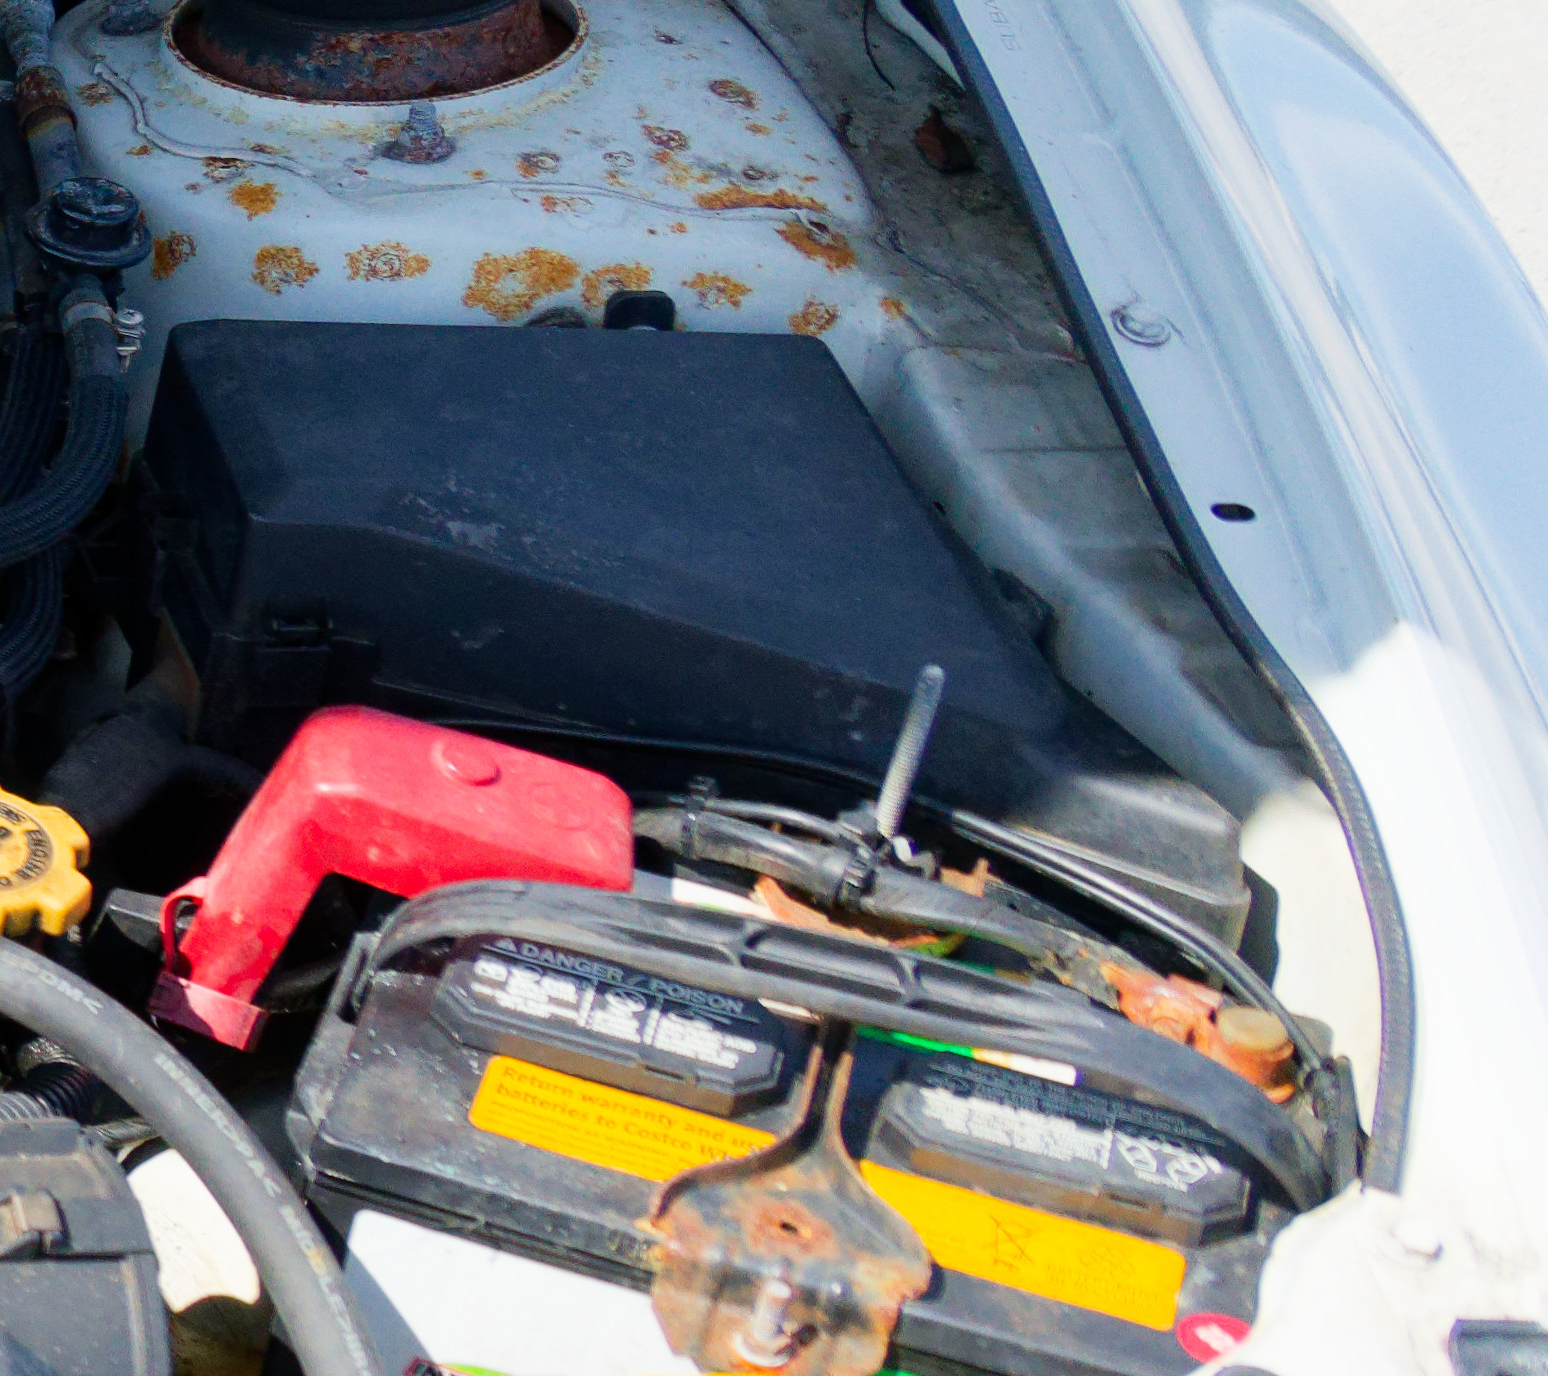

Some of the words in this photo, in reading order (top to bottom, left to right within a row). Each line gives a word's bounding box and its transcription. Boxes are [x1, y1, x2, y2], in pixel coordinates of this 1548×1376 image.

[521, 943, 625, 983] DANGER
[651, 978, 744, 1015] POISON
[495, 1083, 590, 1123] batteries
[595, 1114, 617, 1131] to
[622, 1122, 694, 1153] Costco
[502, 1066, 574, 1099] Return
[580, 1093, 676, 1130] warranty
[683, 1121, 726, 1143] and
